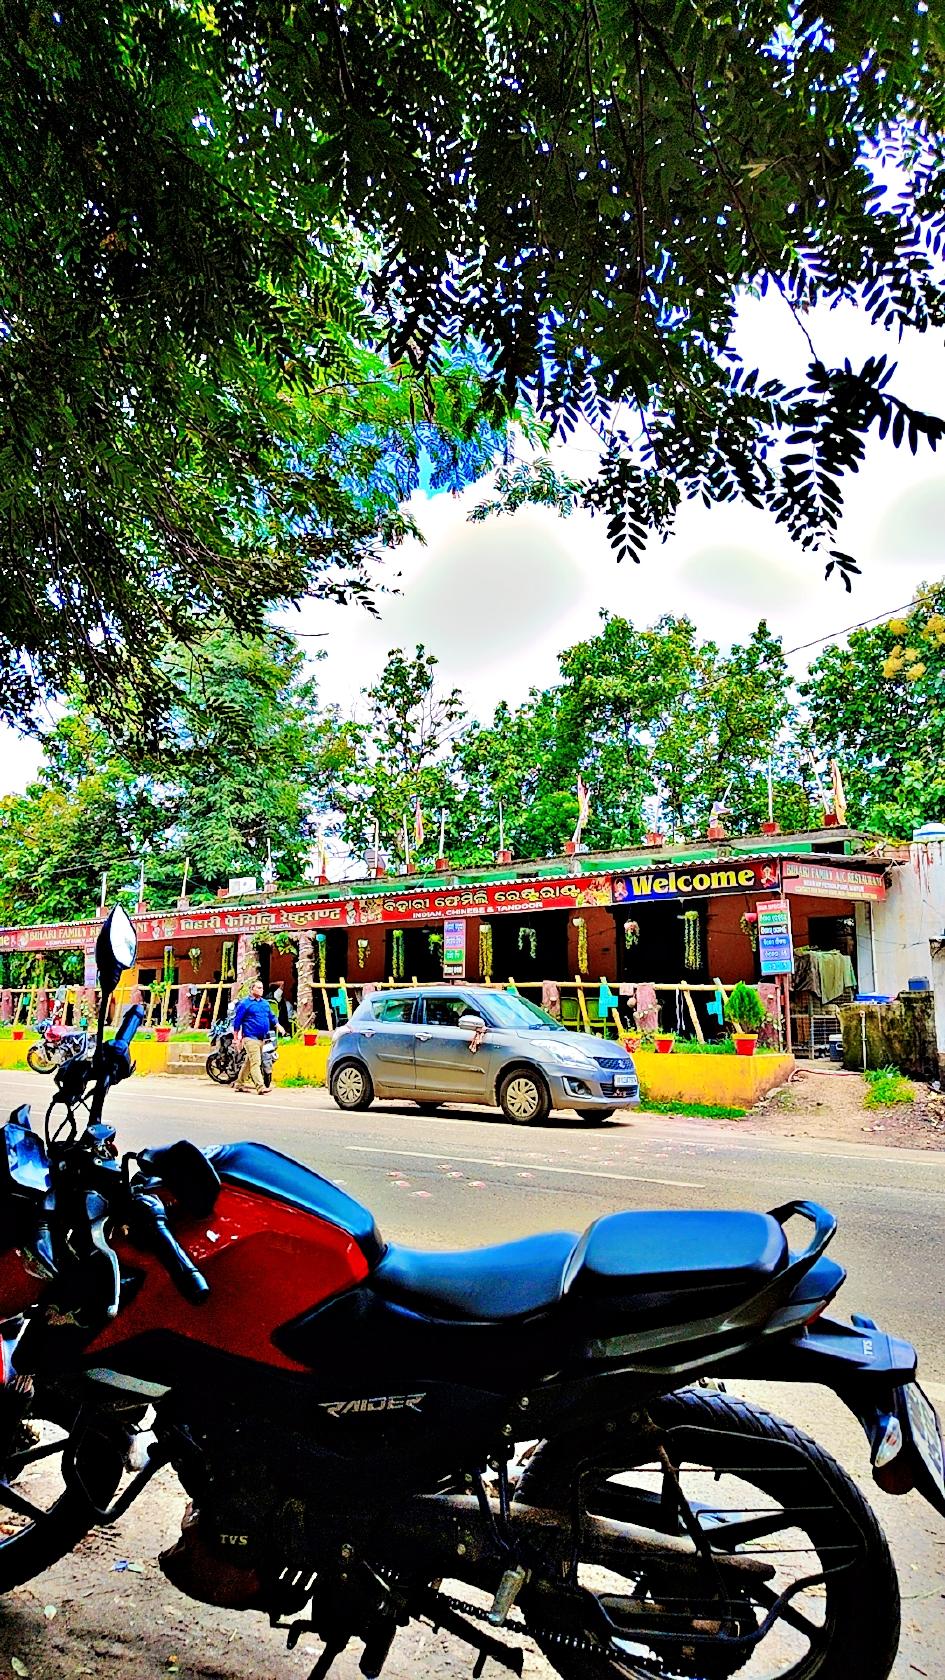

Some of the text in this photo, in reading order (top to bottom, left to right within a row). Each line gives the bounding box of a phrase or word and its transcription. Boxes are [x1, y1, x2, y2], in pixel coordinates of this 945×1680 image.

[811, 867, 833, 880] FAMILY
[629, 869, 755, 896] Welcome
[383, 898, 430, 912] ବିହାରୀ
[435, 890, 488, 907] ଫେମିଲି
[496, 902, 543, 912] TANDOOR
[180, 916, 221, 931] बिहारी
[30, 929, 56, 941] BIHARI
[58, 927, 87, 939] FAMILY
[317, 1392, 427, 1418] RAIDER
[220, 1534, 248, 1545] TVS
